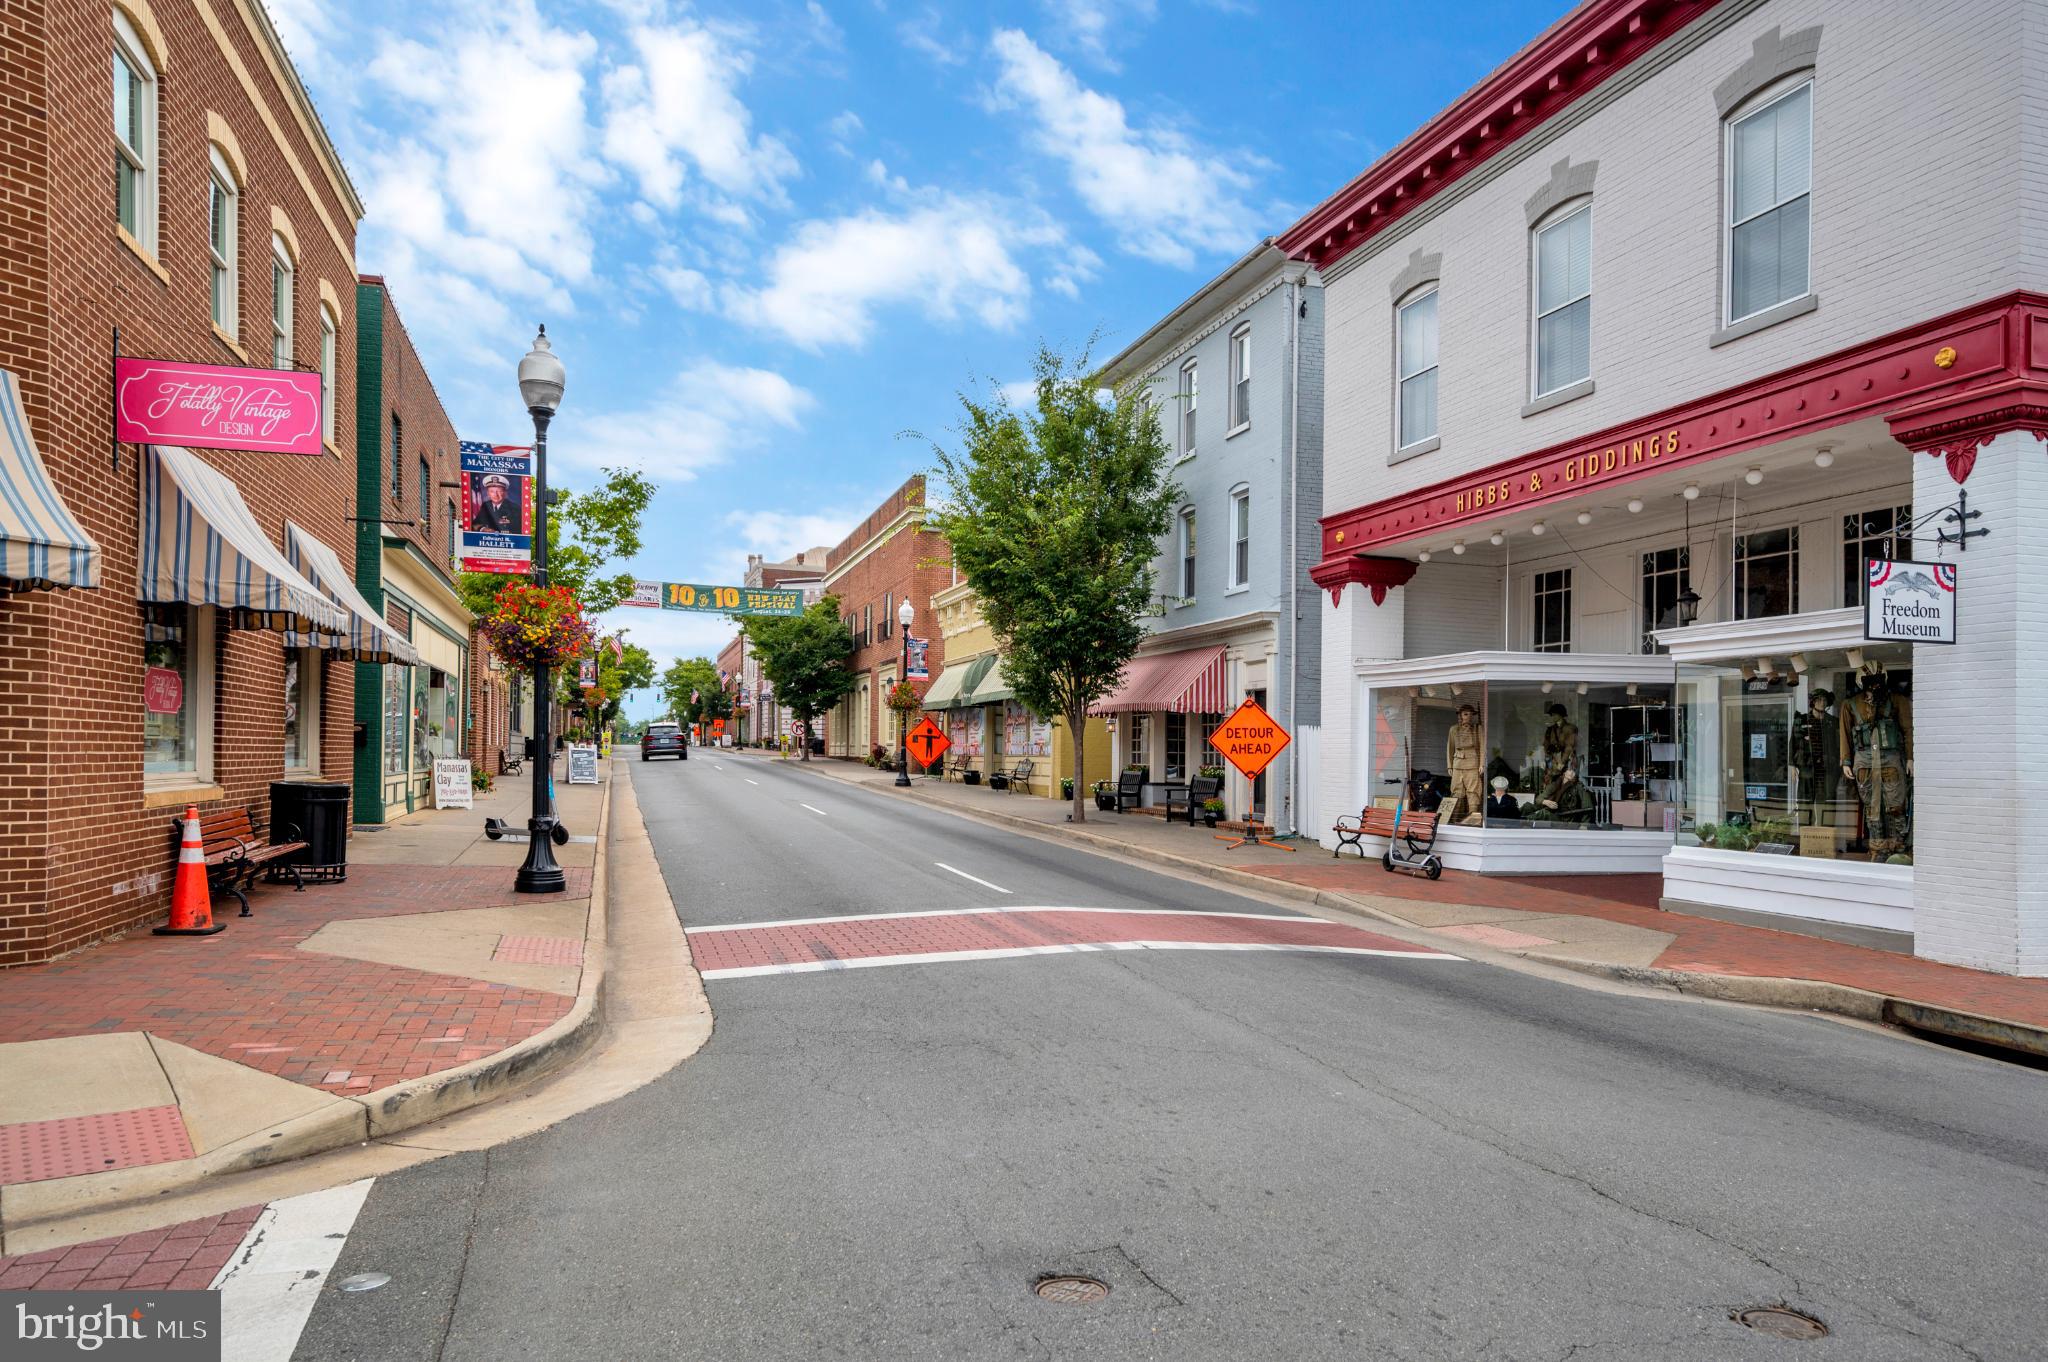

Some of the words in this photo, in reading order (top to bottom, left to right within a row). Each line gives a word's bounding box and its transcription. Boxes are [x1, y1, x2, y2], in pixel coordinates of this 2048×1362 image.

[149, 382, 222, 427] Totally
[221, 386, 292, 436] Vintage
[219, 421, 254, 436] DESIGN
[467, 458, 525, 470] MANASSAS
[1456, 481, 1510, 513] HIBBS
[1530, 472, 1543, 492] &
[1565, 430, 1680, 482] GIDDINGS
[669, 584, 696, 606] 10
[713, 587, 740, 609] 10
[772, 594, 797, 602] PLAY
[748, 601, 796, 609] FESTIVAL
[1881, 598, 1941, 619] Freedom
[1881, 616, 1941, 637] Museum
[1226, 728, 1274, 738] DETOUR
[1230, 743, 1271, 754] AHEAD
[436, 762, 468, 774] Manassas
[436, 774, 451, 787] Clay
